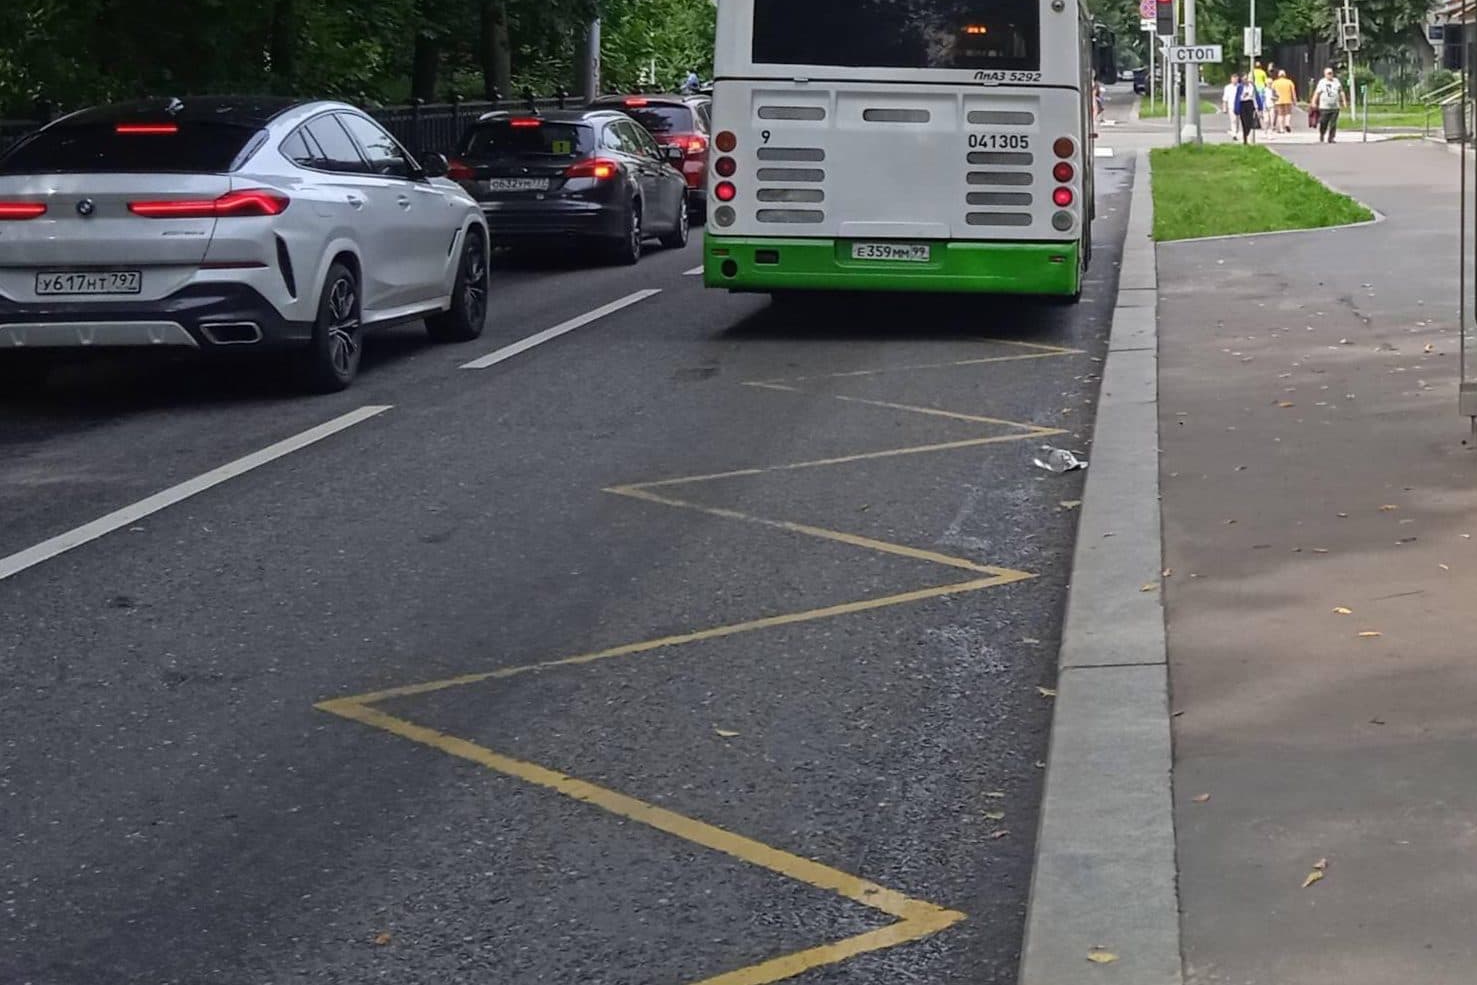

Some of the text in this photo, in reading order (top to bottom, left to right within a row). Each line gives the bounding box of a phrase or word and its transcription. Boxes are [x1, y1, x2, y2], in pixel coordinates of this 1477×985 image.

[1177, 48, 1215, 61] СТОП
[1010, 72, 1041, 83] 5292
[761, 130, 771, 144] 9
[968, 134, 1029, 149] 041305
